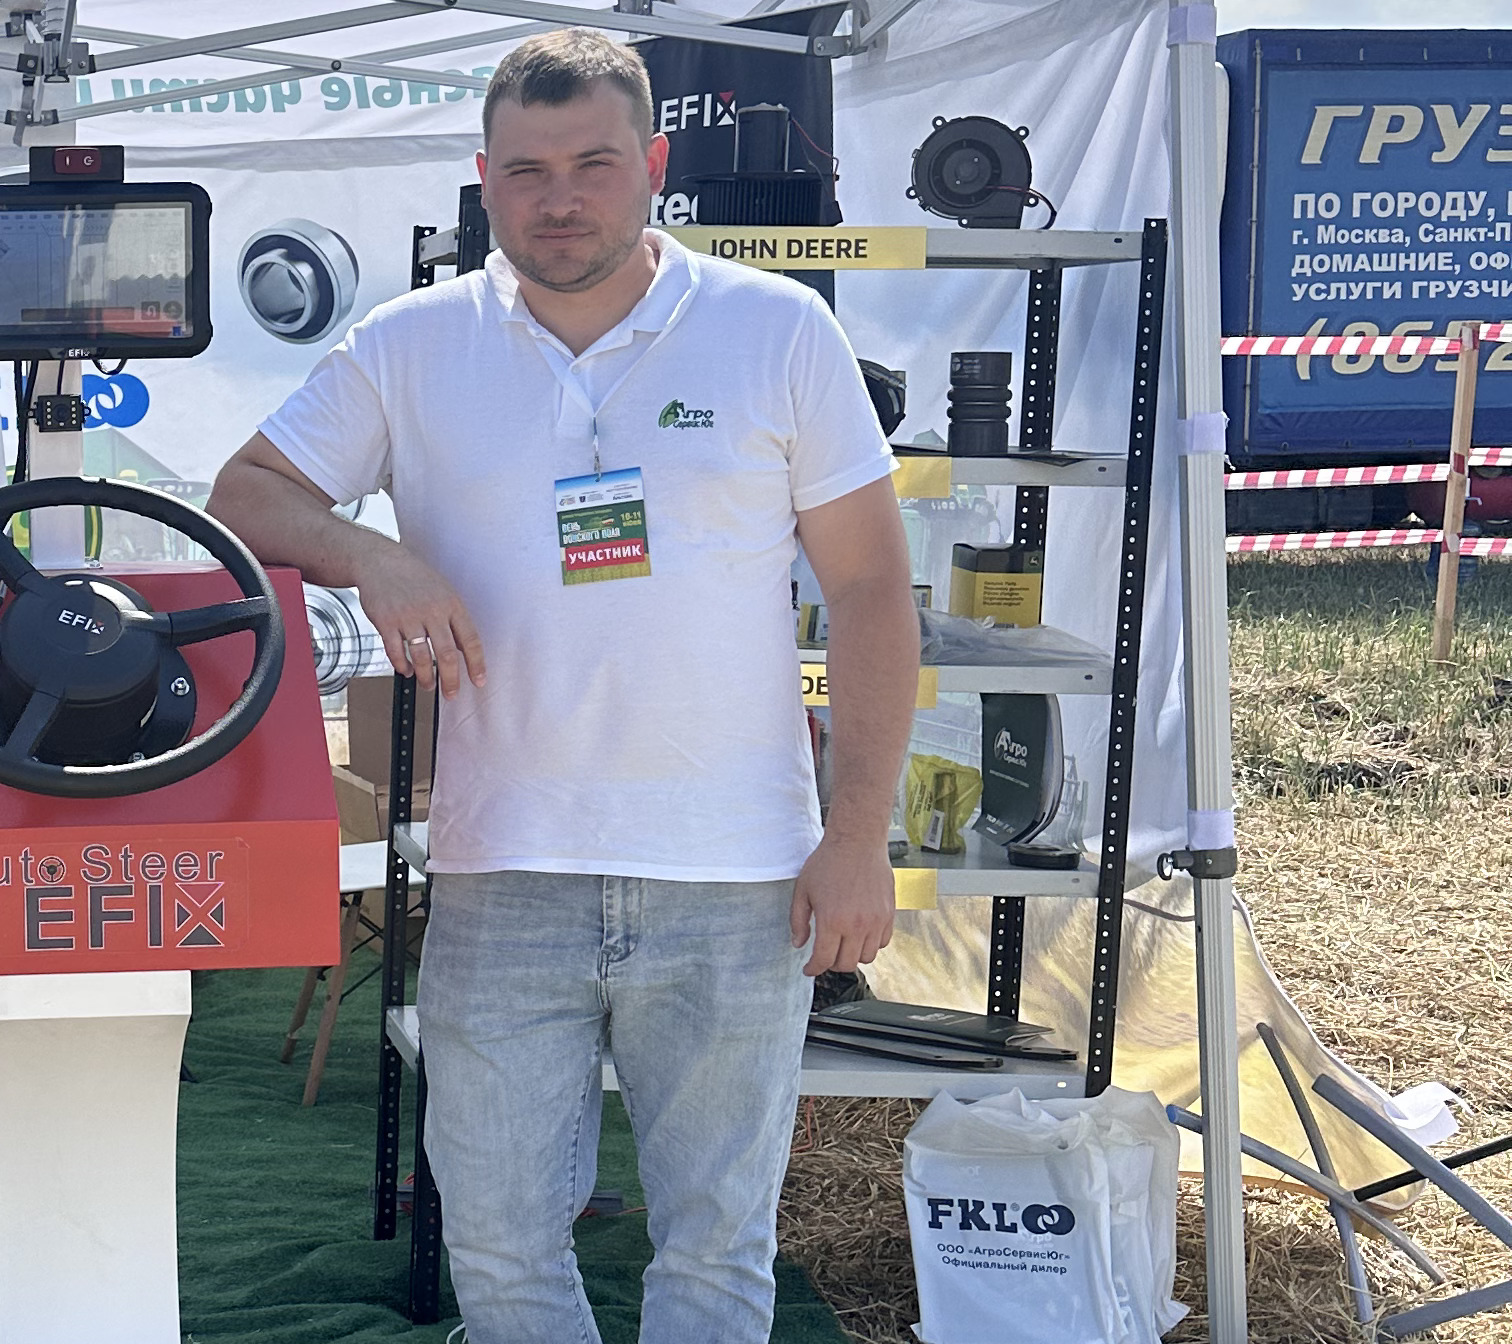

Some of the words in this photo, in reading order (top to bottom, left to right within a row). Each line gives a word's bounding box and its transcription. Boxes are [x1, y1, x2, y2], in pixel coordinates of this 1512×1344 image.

[659, 90, 736, 133] EFIX
[1293, 192, 1341, 219] ПО
[1352, 190, 1496, 222] ГОРОДУ,
[787, 238, 868, 260] DEERE
[1292, 229, 1309, 245] г.
[1316, 224, 1411, 248] Москва,
[1291, 251, 1461, 277] ДОМАШНИЕ,
[1292, 280, 1402, 301] УСЛУГИ
[568, 543, 642, 565] УЧАСТНИК
[58, 609, 105, 635] EFIX
[80, 843, 226, 883] Steer
[24, 881, 226, 952] EFIX
[927, 1197, 1018, 1234] FKL
[937, 1243, 965, 1254] ООО
[941, 1255, 1028, 1272] Официальный
[1030, 1263, 1068, 1276] дилер
